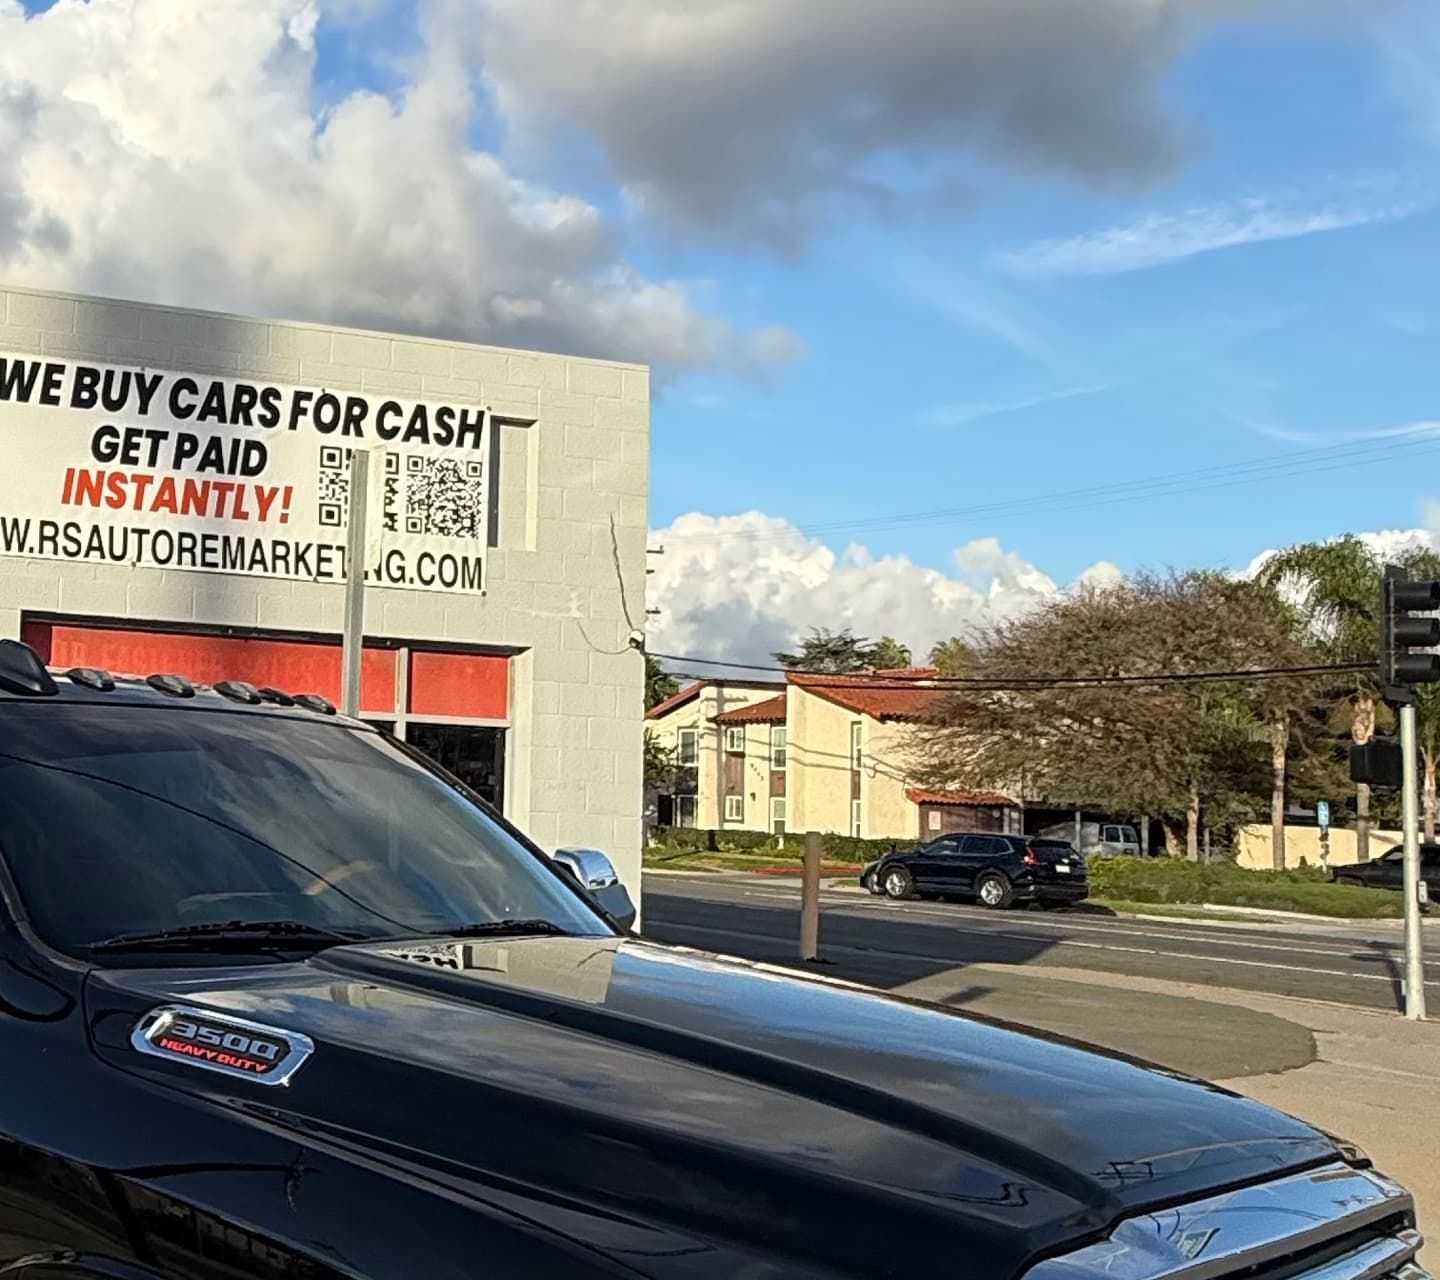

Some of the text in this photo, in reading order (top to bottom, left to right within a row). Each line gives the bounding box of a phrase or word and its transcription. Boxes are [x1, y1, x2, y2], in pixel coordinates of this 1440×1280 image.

[70, 366, 164, 416] BUY
[168, 377, 283, 428] CARS
[288, 391, 372, 437] FOR
[375, 401, 487, 450] CASH
[91, 425, 268, 477] GET PAID
[61, 468, 294, 524] INSTANTLY!
[160, 1038, 269, 1072] HEAVY DUTY
[171, 1020, 279, 1060] 3500
